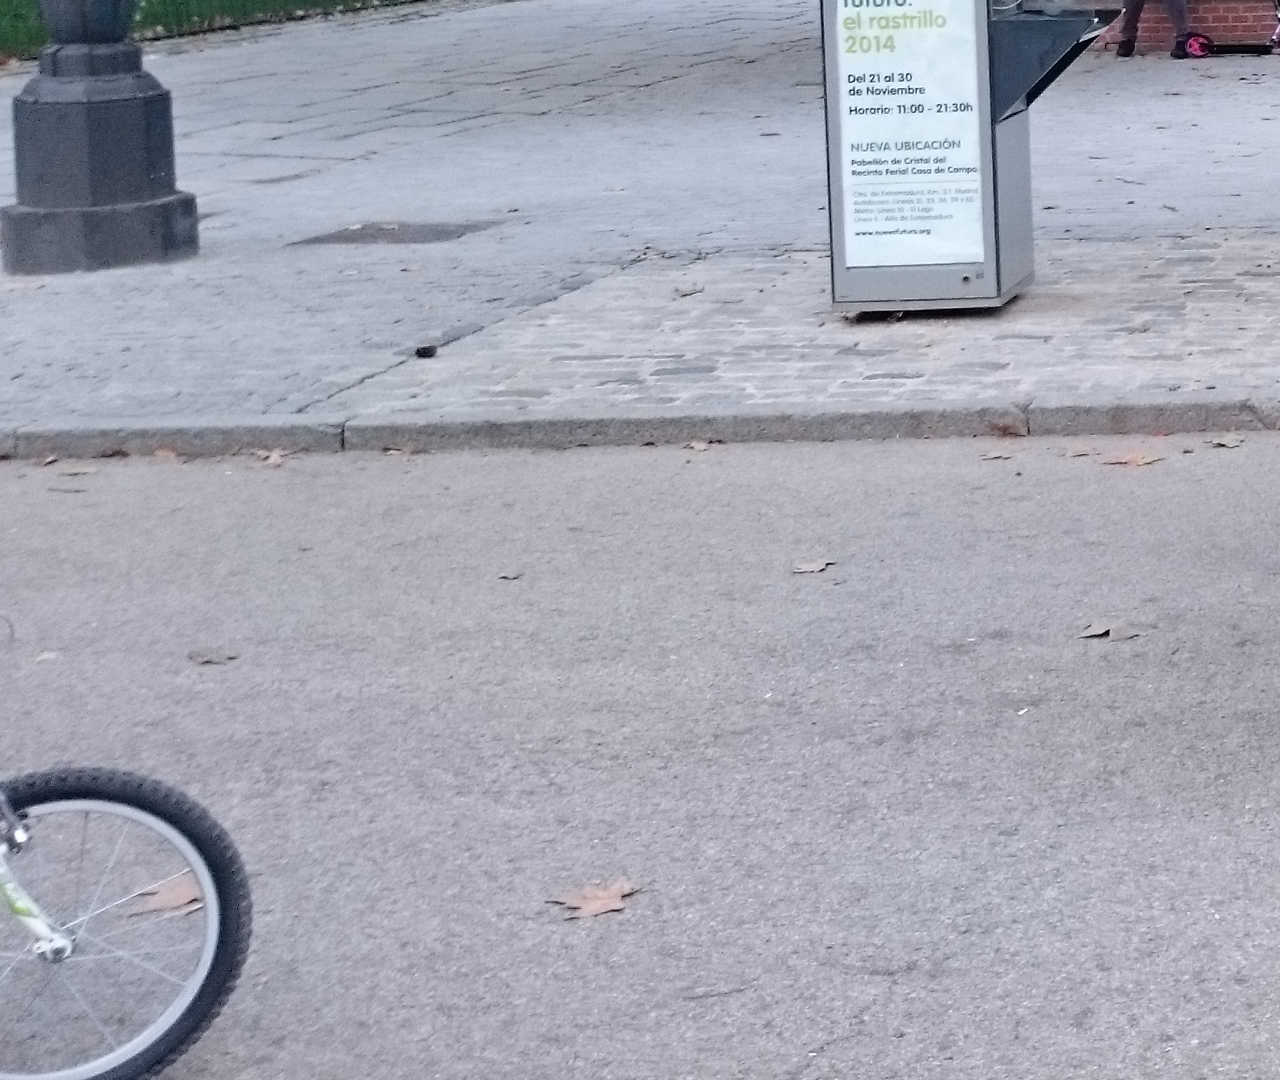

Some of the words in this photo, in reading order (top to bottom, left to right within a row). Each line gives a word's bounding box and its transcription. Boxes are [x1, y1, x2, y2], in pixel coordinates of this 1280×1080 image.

[843, 12, 862, 30] el
[869, 10, 947, 29] rastrillo
[844, 35, 896, 54] 2014
[847, 74, 866, 83] Del
[869, 74, 881, 83] 21
[884, 73, 895, 83] al
[898, 73, 912, 82] 30
[849, 87, 863, 96] de
[866, 85, 926, 95] Noviembre
[849, 104, 893, 115] Horario:
[897, 104, 925, 114] 11:00
[936, 102, 973, 113] 21:30h
[851, 142, 891, 152] NUEVA
[895, 138, 961, 151] UBICACIÓN
[904, 157, 931, 165] Cristal
[933, 156, 946, 164] del
[885, 168, 909, 176] Ferial
[911, 167, 932, 175] Casa
[947, 166, 977, 174] Campo
